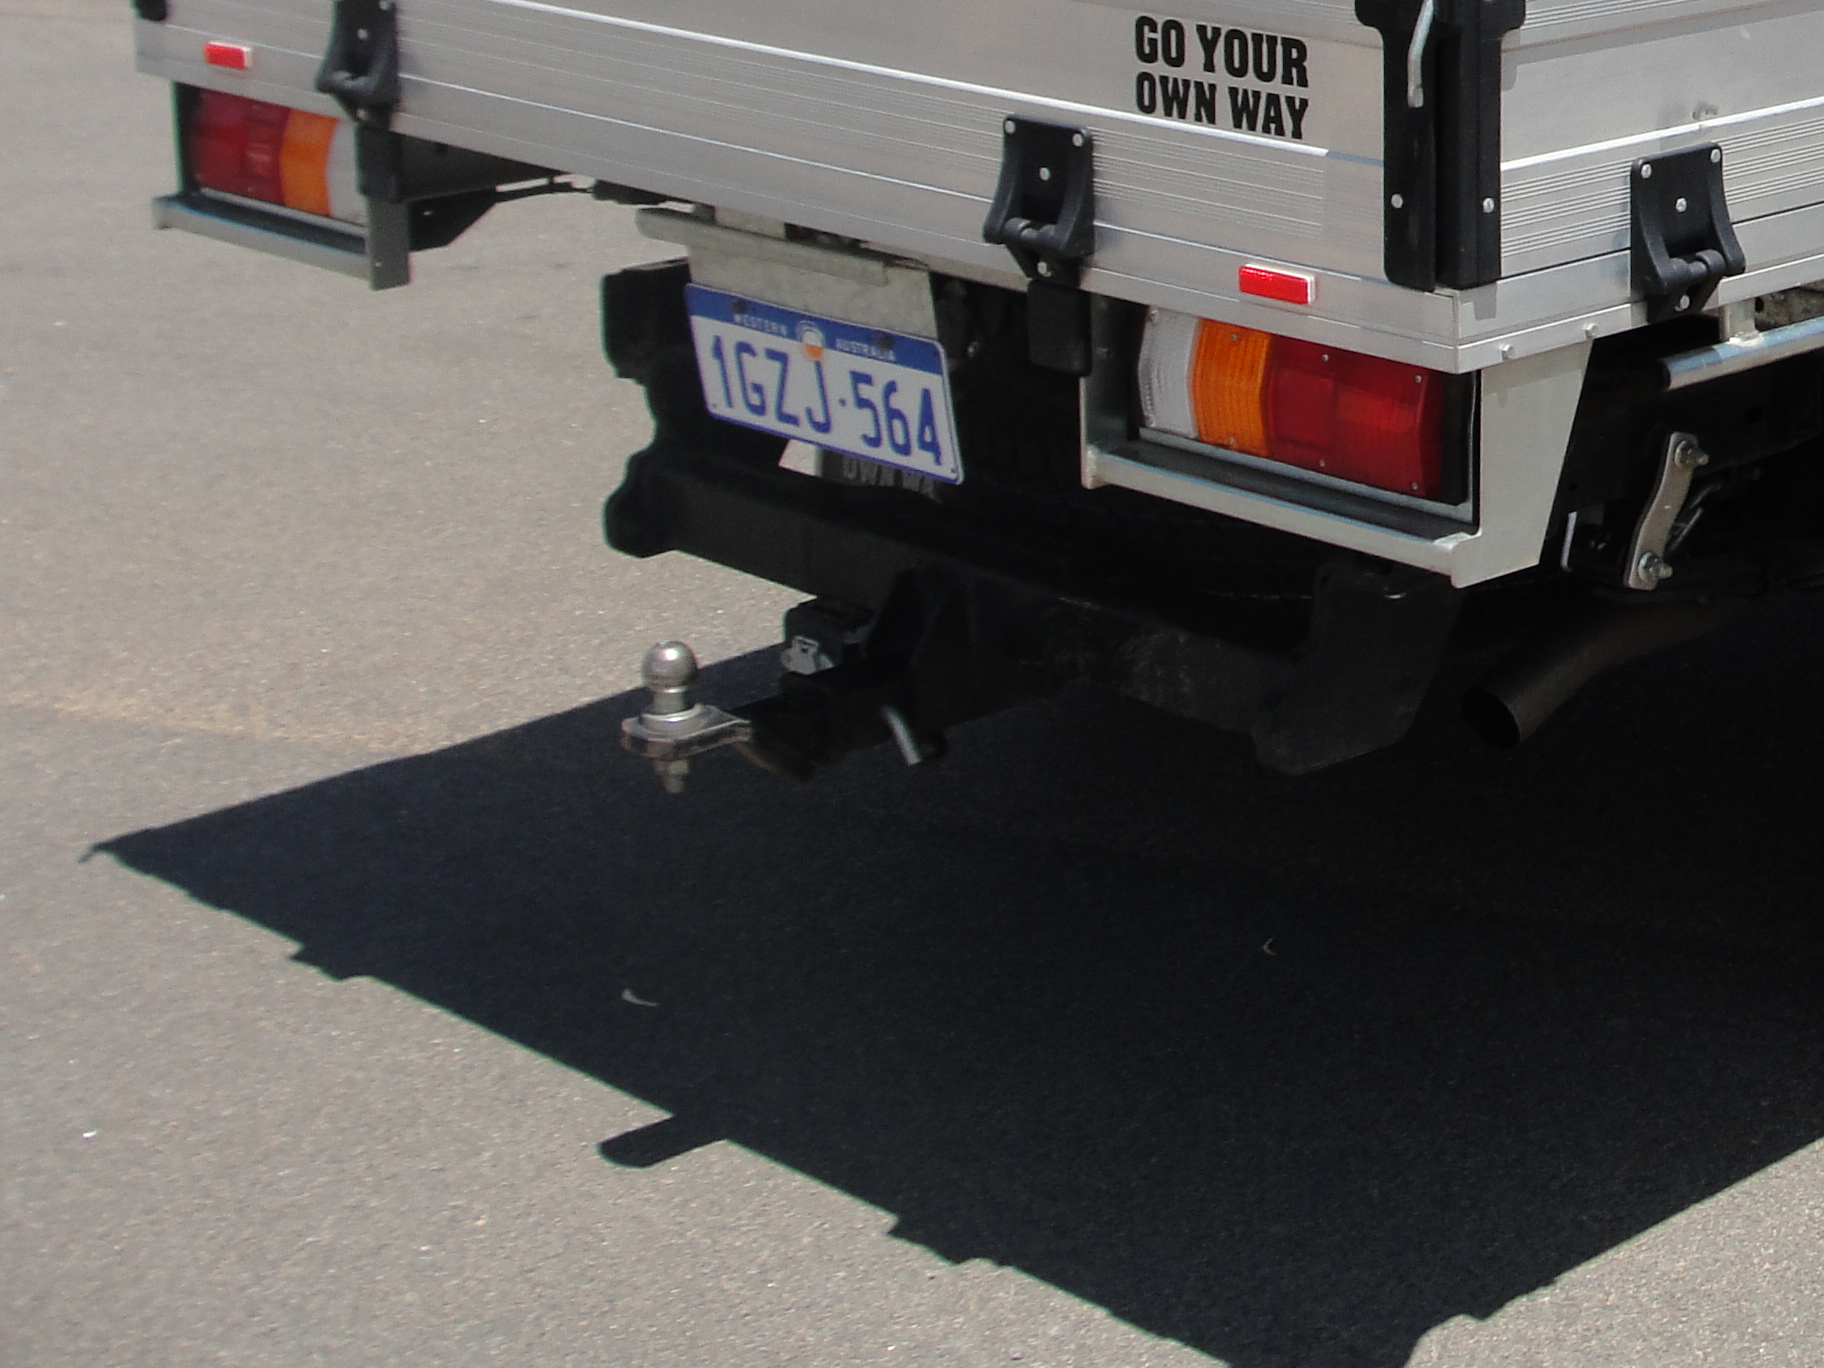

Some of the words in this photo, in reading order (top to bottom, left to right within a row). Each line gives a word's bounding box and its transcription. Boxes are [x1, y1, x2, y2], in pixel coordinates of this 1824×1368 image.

[1135, 15, 1185, 68] GO
[1195, 24, 1309, 88] YOUR
[1136, 71, 1217, 125] OWN
[1228, 86, 1309, 139] WAY
[733, 314, 787, 338] WESTERN
[835, 337, 896, 361] AUSTRALIA
